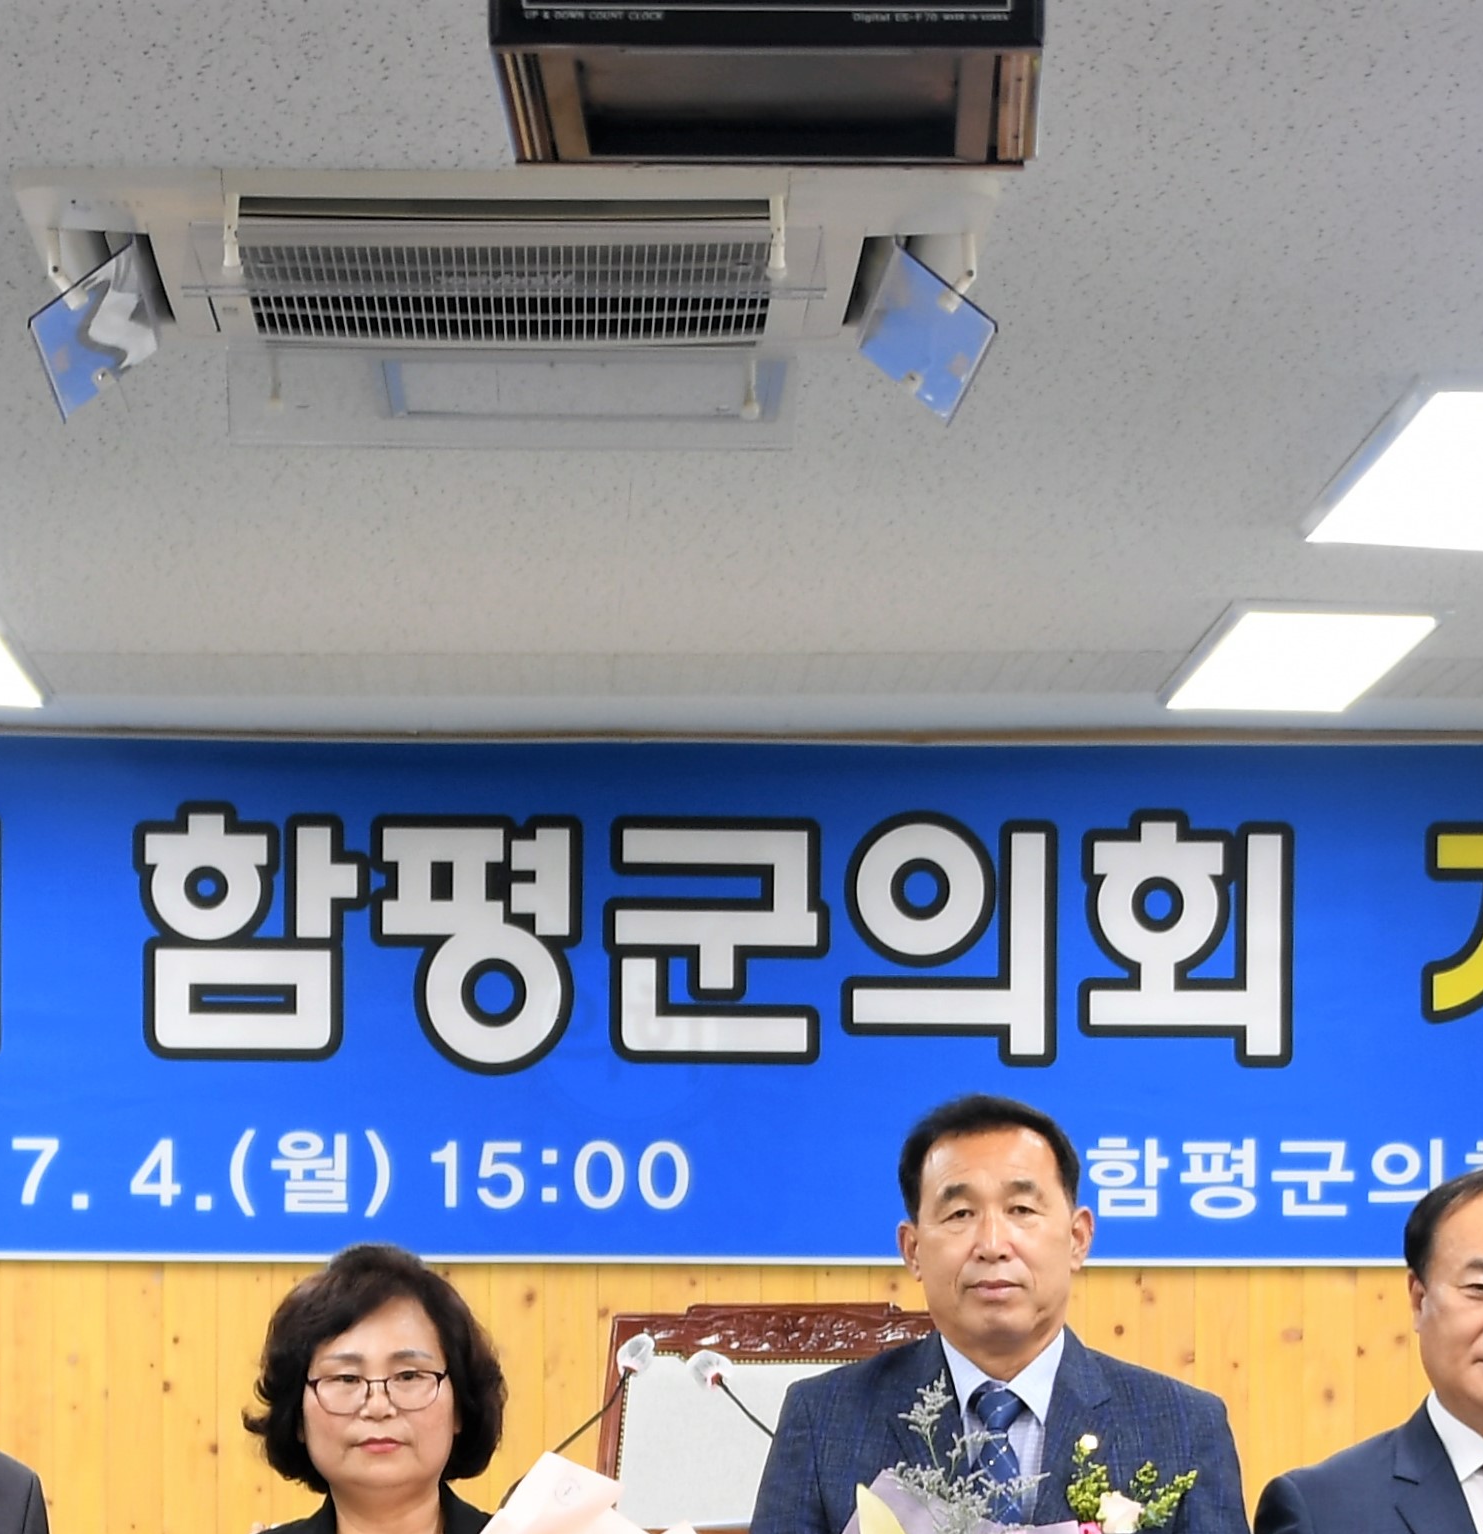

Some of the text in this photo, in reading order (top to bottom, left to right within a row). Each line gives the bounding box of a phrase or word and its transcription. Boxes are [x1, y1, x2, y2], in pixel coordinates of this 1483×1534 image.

[133, 800, 1295, 1076] 함평군의회
[12, 1137, 89, 1210] 7.
[430, 1139, 691, 1210] 15:00
